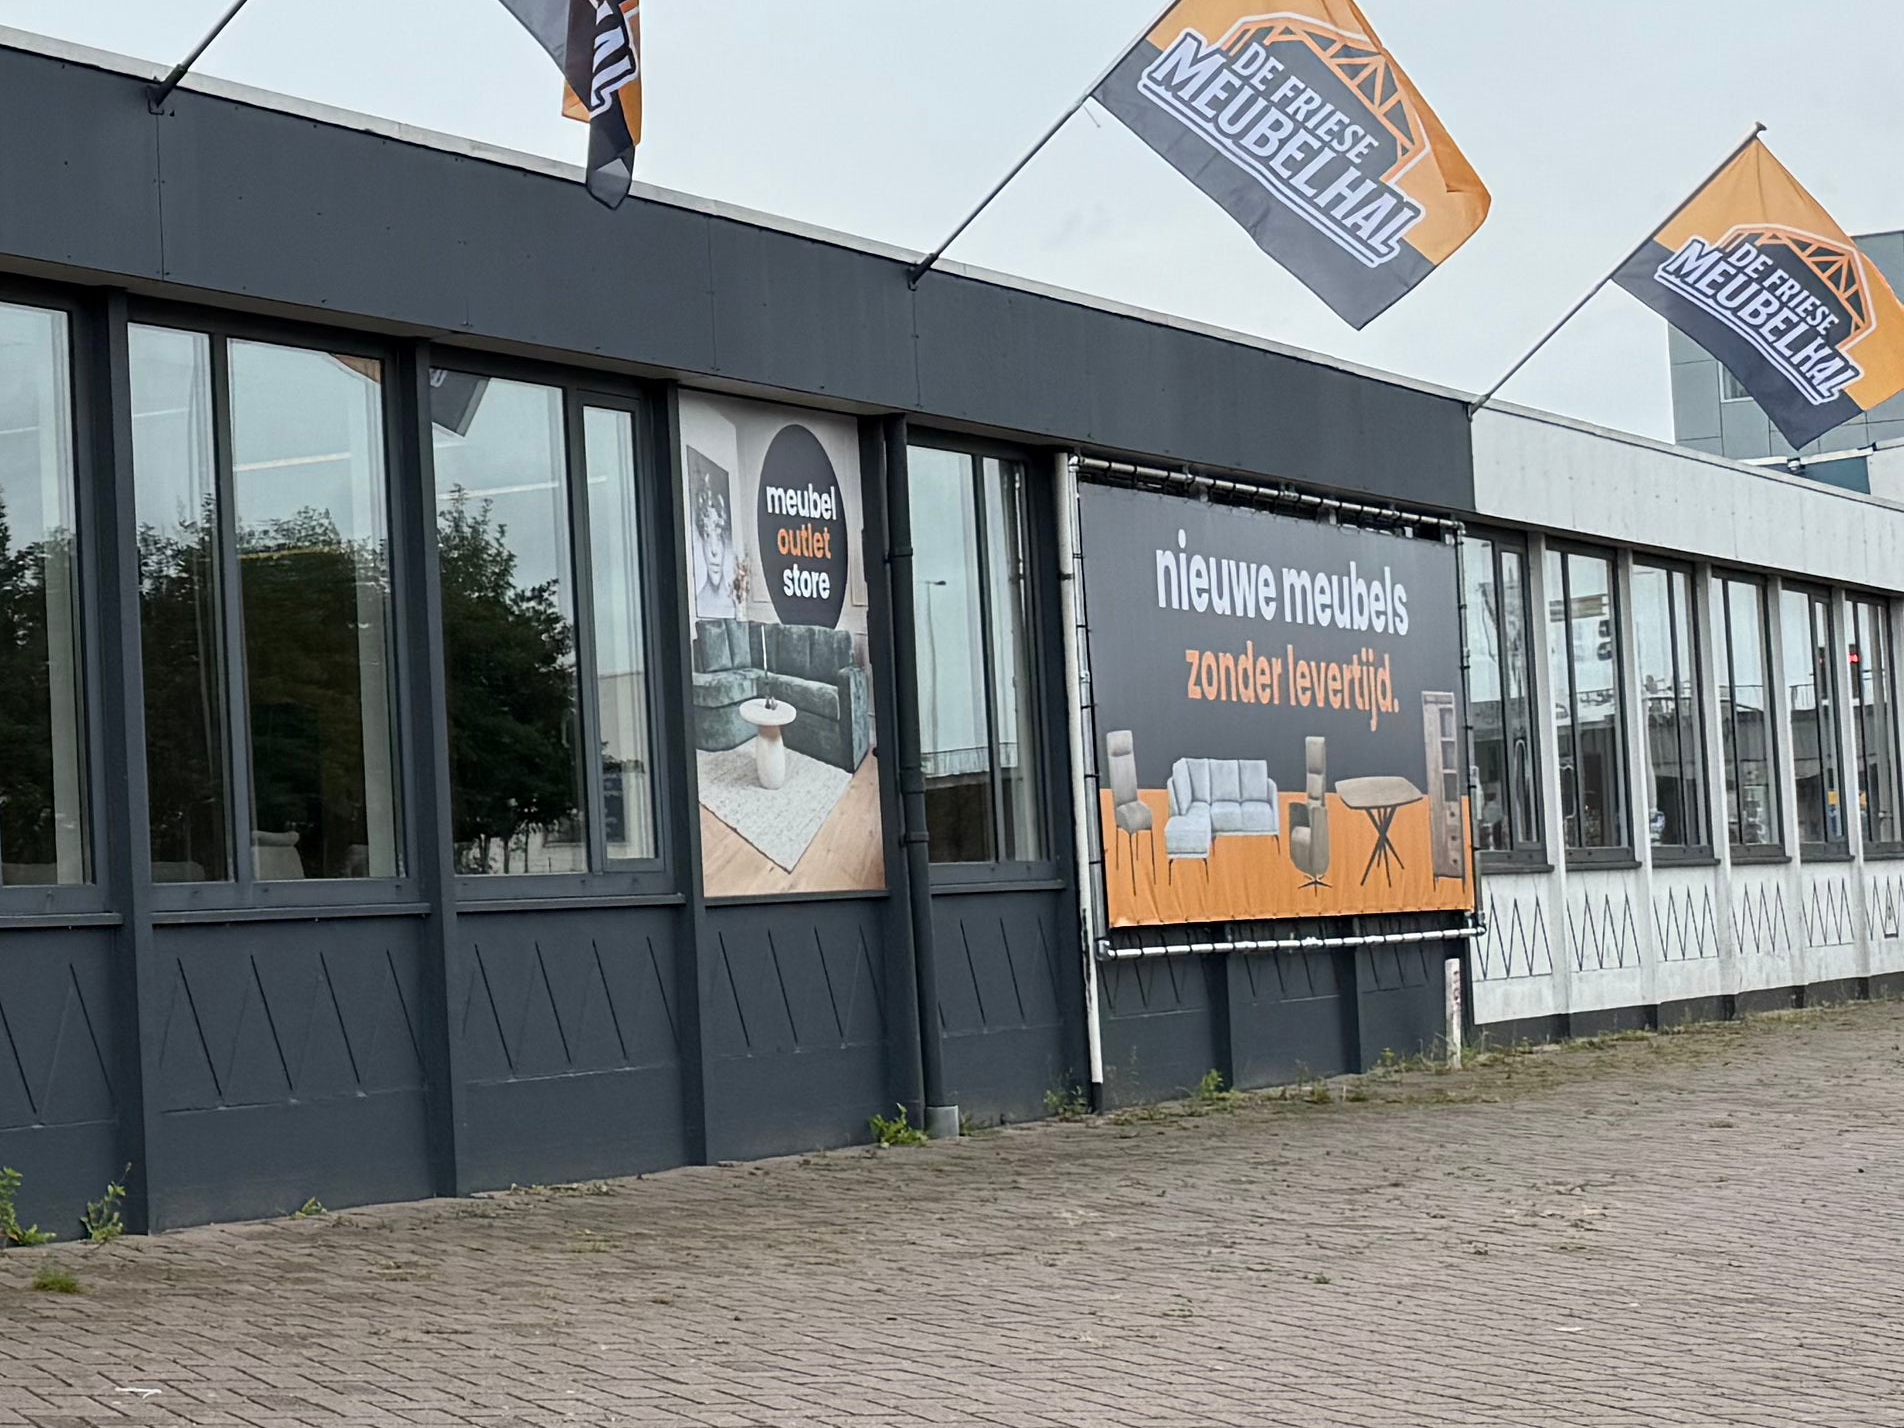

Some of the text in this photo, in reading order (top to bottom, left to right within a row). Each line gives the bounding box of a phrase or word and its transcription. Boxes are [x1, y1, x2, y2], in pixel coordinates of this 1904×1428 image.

[1151, 35, 1414, 256] MEUBELHAL
[1230, 42, 1379, 165] DE FRIESE
[1666, 238, 1855, 401] MEUBELHAL
[1727, 242, 1839, 337] DE FRIESE
[765, 482, 837, 522] meubel
[776, 521, 833, 560] outlet
[782, 561, 831, 600] store
[1154, 528, 1410, 637] nieuwe meubels
[1185, 639, 1401, 733] zonder levertijd.
